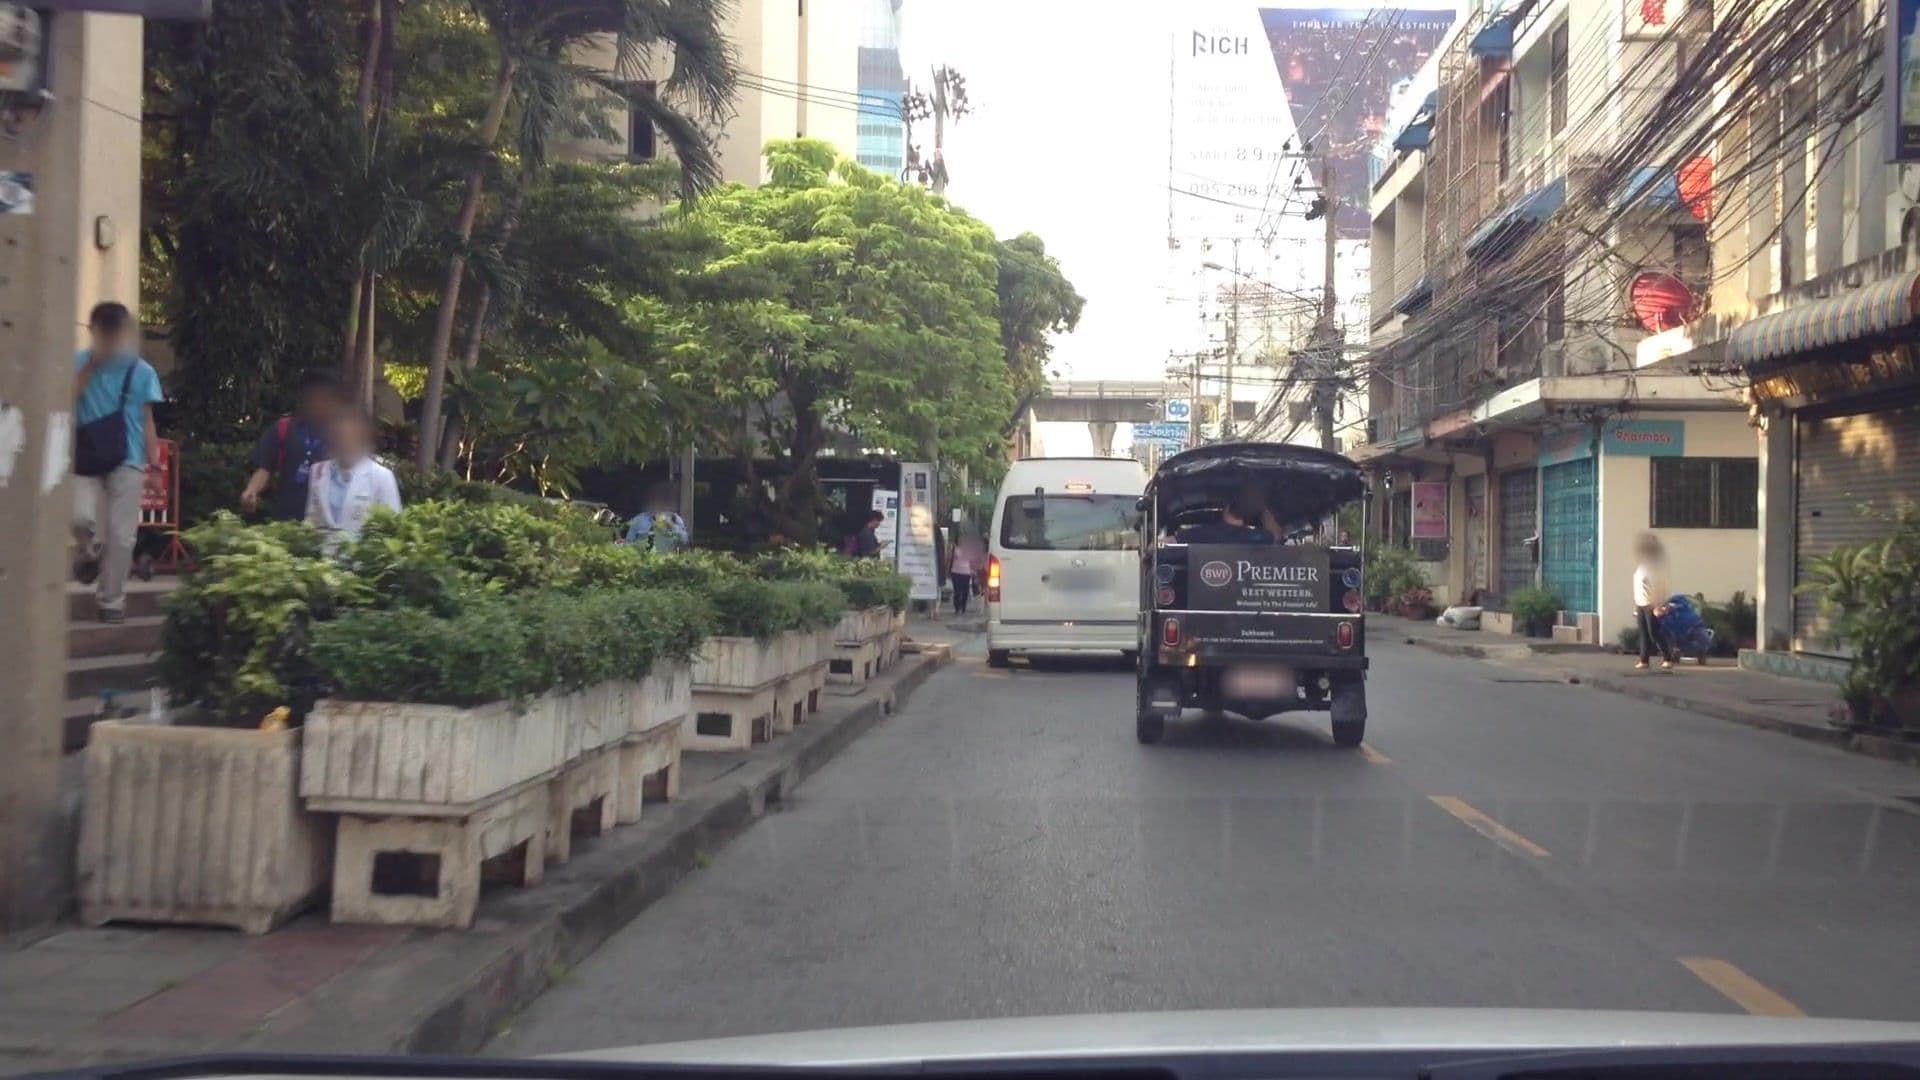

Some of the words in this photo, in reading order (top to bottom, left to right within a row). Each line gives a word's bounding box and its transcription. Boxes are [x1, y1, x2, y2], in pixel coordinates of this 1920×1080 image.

[1192, 29, 1249, 57] RICH
[1204, 568, 1229, 579] BWP
[1242, 588, 1264, 598] BEST
